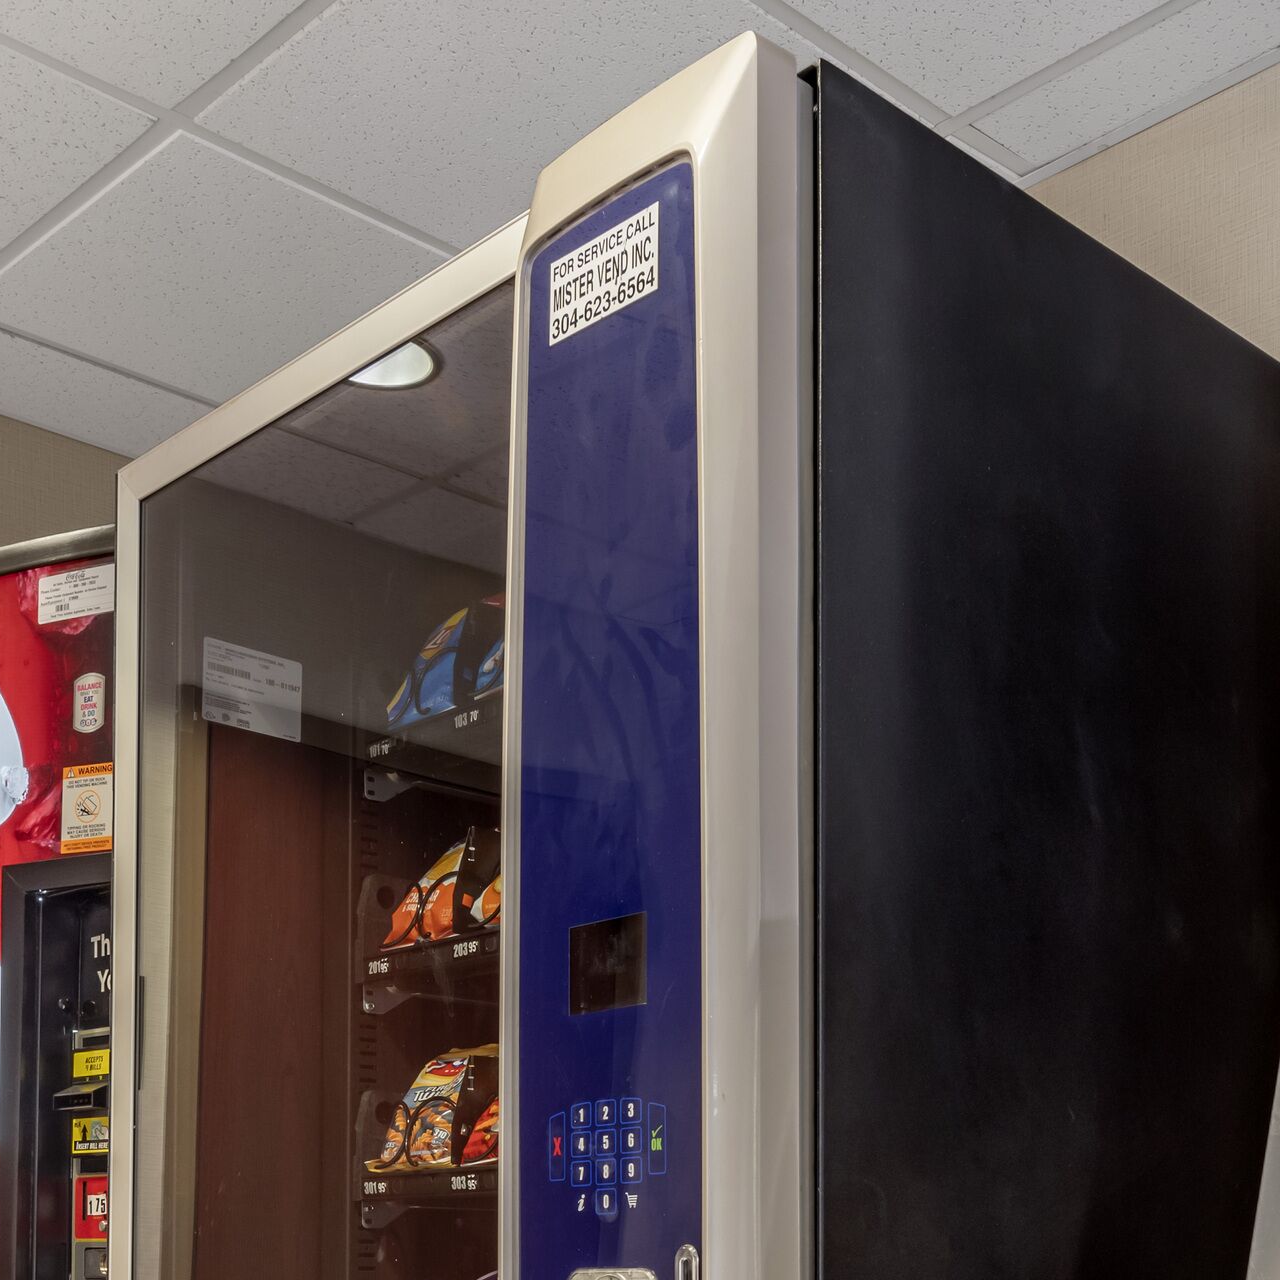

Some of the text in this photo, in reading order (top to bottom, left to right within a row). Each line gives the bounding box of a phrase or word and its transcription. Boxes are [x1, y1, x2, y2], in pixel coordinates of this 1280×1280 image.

[553, 212, 655, 282] FOR SERVICE CALL
[553, 236, 655, 313] MISTER VEND INC.
[552, 265, 656, 340] 304-623-6564
[77, 682, 102, 691] BALANCE
[78, 764, 112, 775] WARNING
[453, 944, 468, 958] 203
[369, 961, 381, 975] 201
[85, 1056, 104, 1064] ACCEPTS
[579, 1108, 584, 1122] 1
[602, 1106, 609, 1120] 2
[627, 1103, 634, 1117] 3
[578, 1138, 585, 1151] 4
[602, 1135, 609, 1149] 5
[627, 1133, 634, 1147] 6
[651, 1138, 662, 1151] OK
[579, 1167, 585, 1180] 7
[602, 1164, 609, 1179] 8
[627, 1163, 634, 1177] 9
[364, 1182, 377, 1195] 301
[451, 1176, 466, 1190] 303
[602, 1194, 609, 1209] 0
